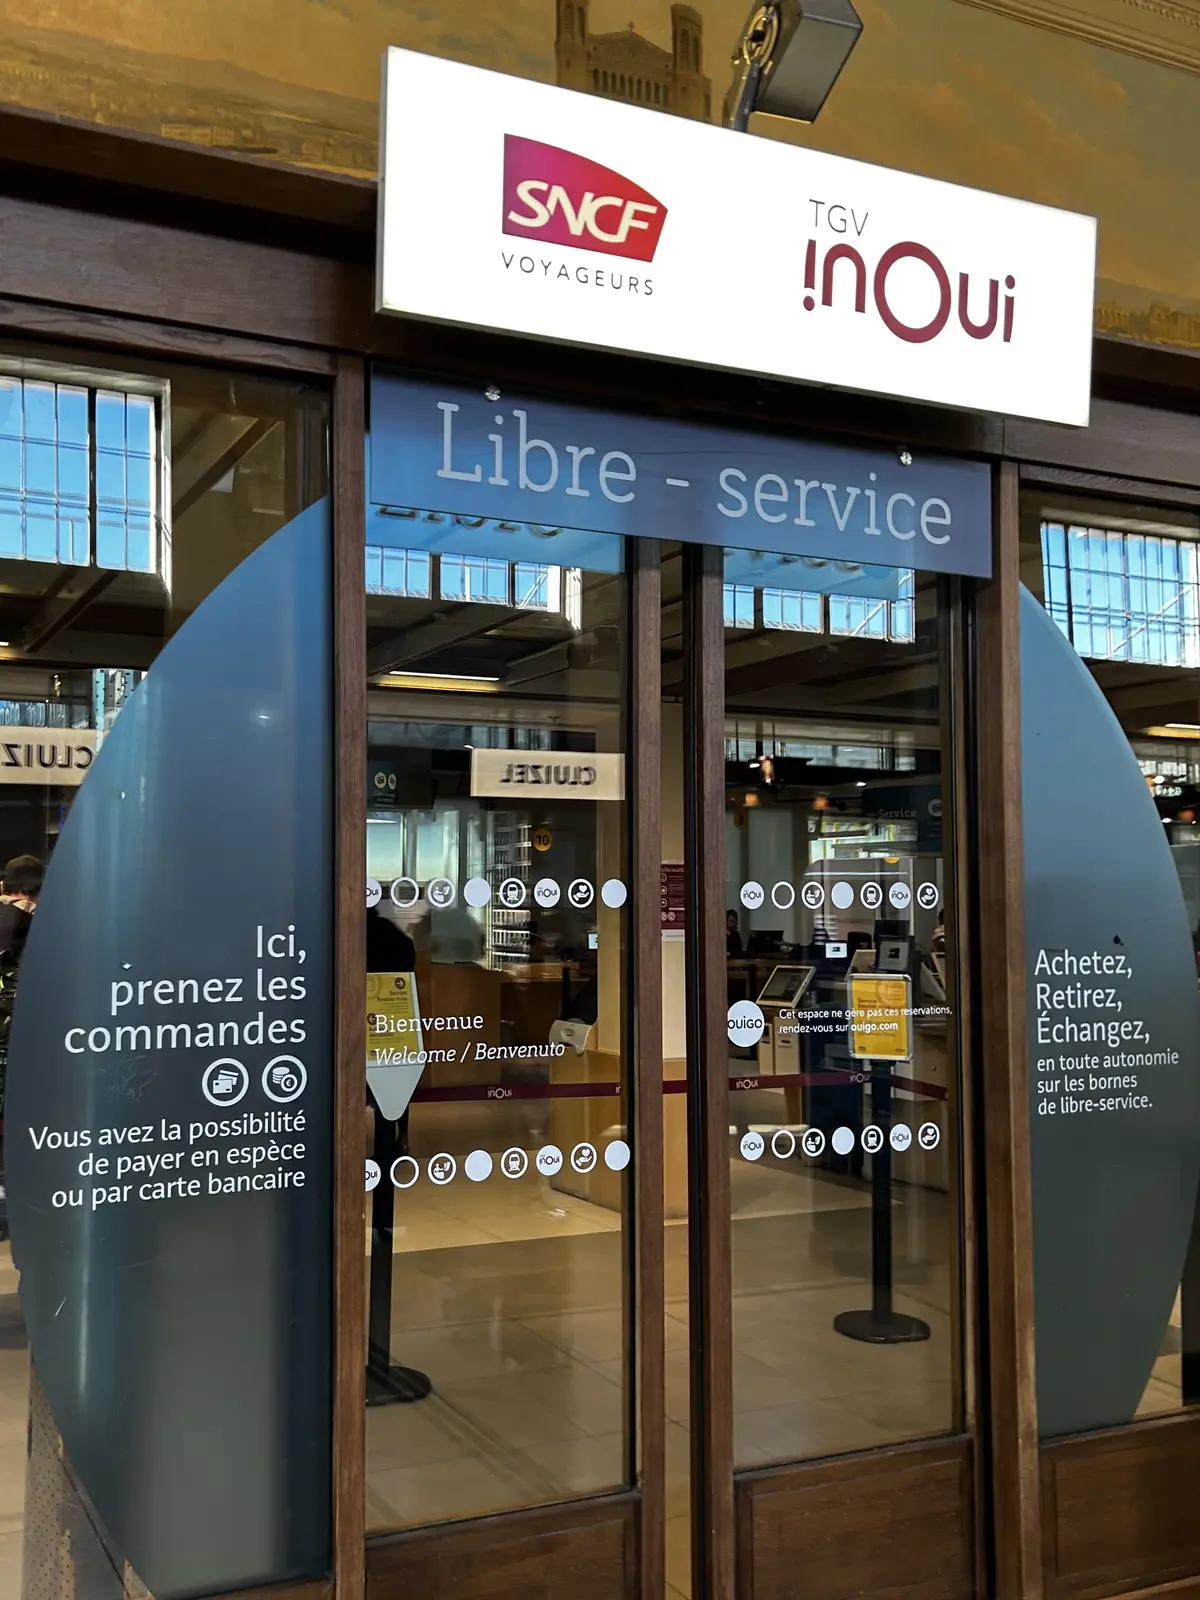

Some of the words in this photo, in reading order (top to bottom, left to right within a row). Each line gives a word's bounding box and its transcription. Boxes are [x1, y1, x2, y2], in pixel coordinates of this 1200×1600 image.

[507, 180, 658, 243] SNCF
[808, 198, 869, 237] TGV
[501, 251, 654, 296] VOYAGEURS
[436, 401, 638, 504] Libre
[716, 467, 953, 546] service
[535, 834, 549, 847] 10
[256, 924, 308, 964] Ici,
[1034, 949, 1133, 979] Achetez,
[111, 977, 244, 1016] prenez
[256, 968, 307, 1001] les
[1036, 982, 1123, 1012] Retirez,
[64, 1011, 307, 1054] commandes
[374, 1013, 485, 1035] Bienvenue
[779, 1008, 796, 1019] Cet
[797, 1009, 829, 1022] espace
[831, 1010, 843, 1018] ne
[845, 1007, 865, 1020] gère
[867, 1009, 883, 1019] pas
[884, 1008, 899, 1016] ces
[779, 1023, 833, 1034] rendez-vous
[835, 1024, 849, 1032] sur
[850, 1021, 899, 1034] ouigo.com
[1037, 1011, 1151, 1048] Échangez,
[374, 1045, 457, 1066] Welcome
[474, 1041, 566, 1061] Benvenuto
[1037, 1058, 1055, 1072] en
[1059, 1053, 1100, 1070] toute
[1103, 1048, 1180, 1068] autonomie
[1037, 1078, 1061, 1094] sur
[1064, 1075, 1085, 1092] les
[1089, 1073, 1138, 1090] bornes
[1038, 1098, 1056, 1115] de
[1060, 1092, 1153, 1114] libre-service.
[29, 1126, 92, 1150] Vous
[98, 1124, 154, 1146] avez
[160, 1119, 181, 1141] la
[189, 1109, 307, 1145] possibilité
[78, 1152, 109, 1177] de
[116, 1150, 185, 1179] payer
[190, 1148, 219, 1168] en
[226, 1139, 306, 1169] espèce
[51, 1188, 83, 1208] ou
[91, 1184, 133, 1211] par
[138, 1178, 201, 1201] carte
[207, 1167, 306, 1195] bancaire
